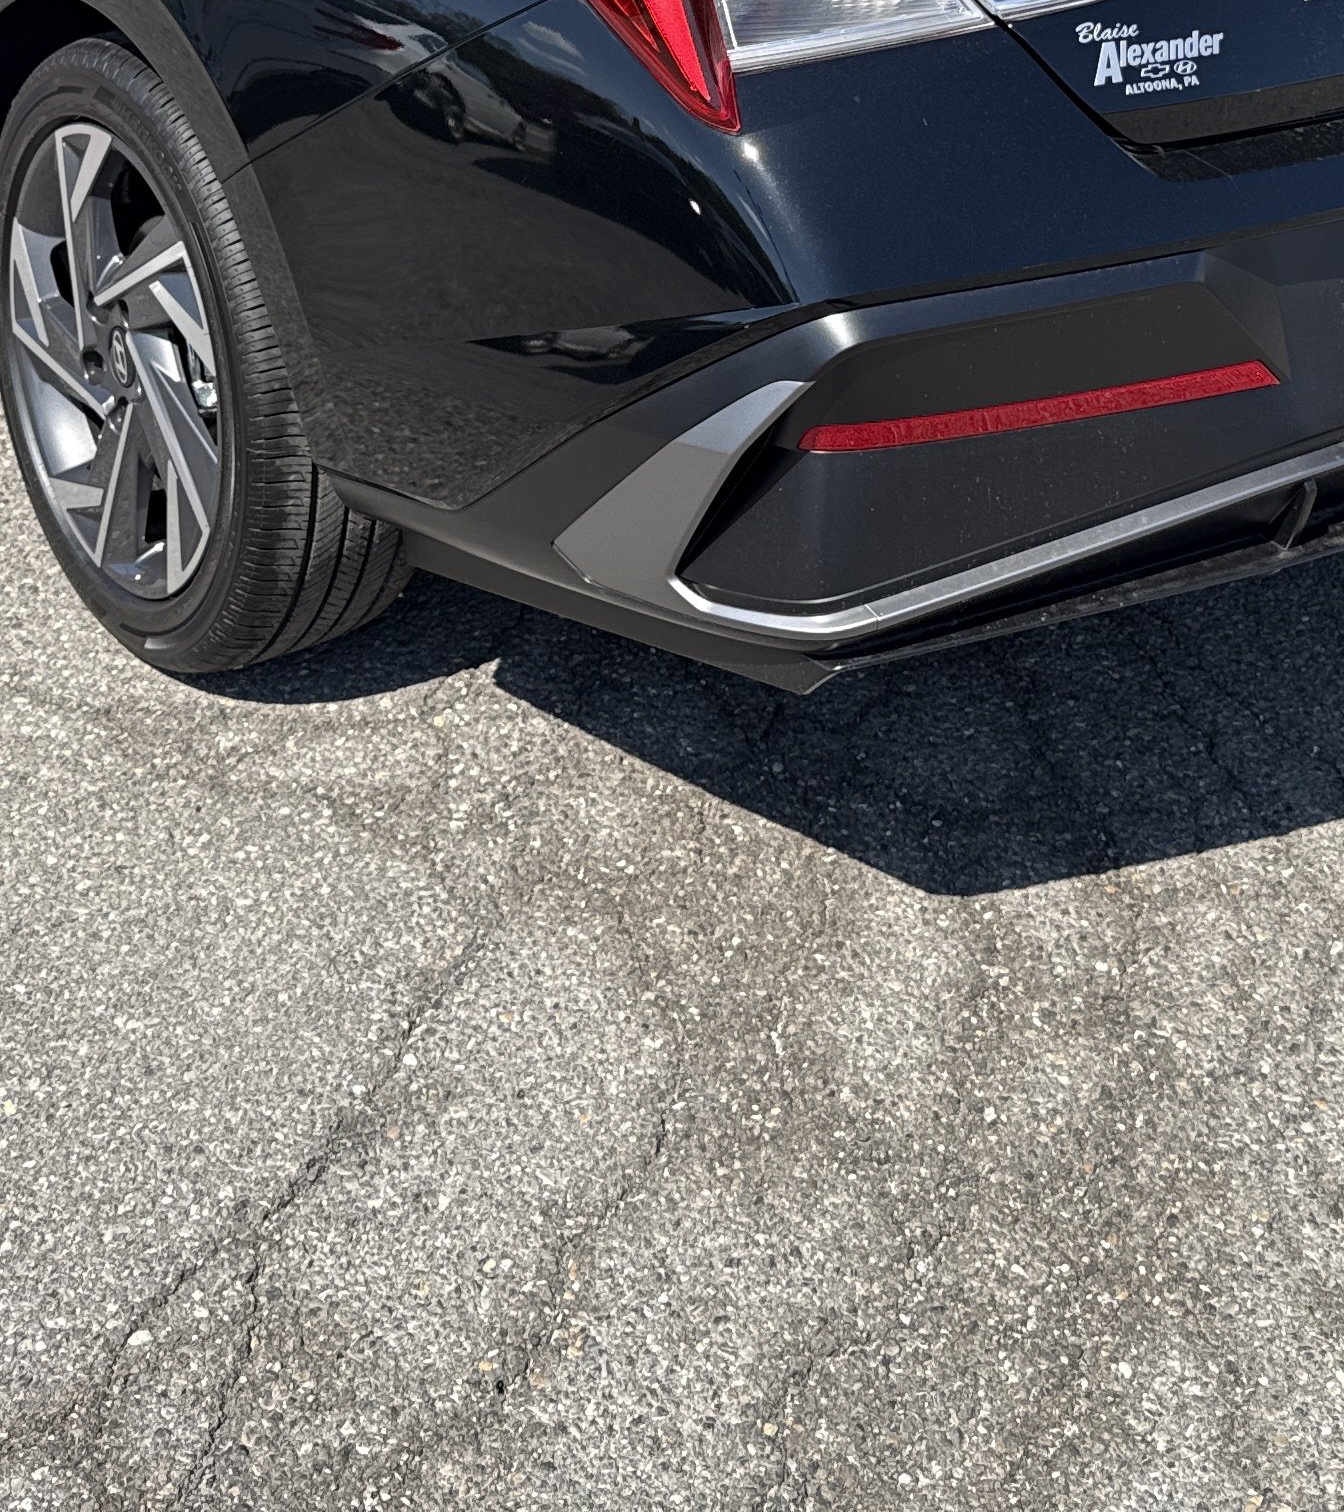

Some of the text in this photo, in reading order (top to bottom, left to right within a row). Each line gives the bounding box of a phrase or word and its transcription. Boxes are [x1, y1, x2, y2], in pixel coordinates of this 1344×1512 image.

[1075, 21, 1139, 44] Blaise
[1093, 29, 1224, 87] Alexander
[1125, 75, 1200, 95] ALTOONA, PA
